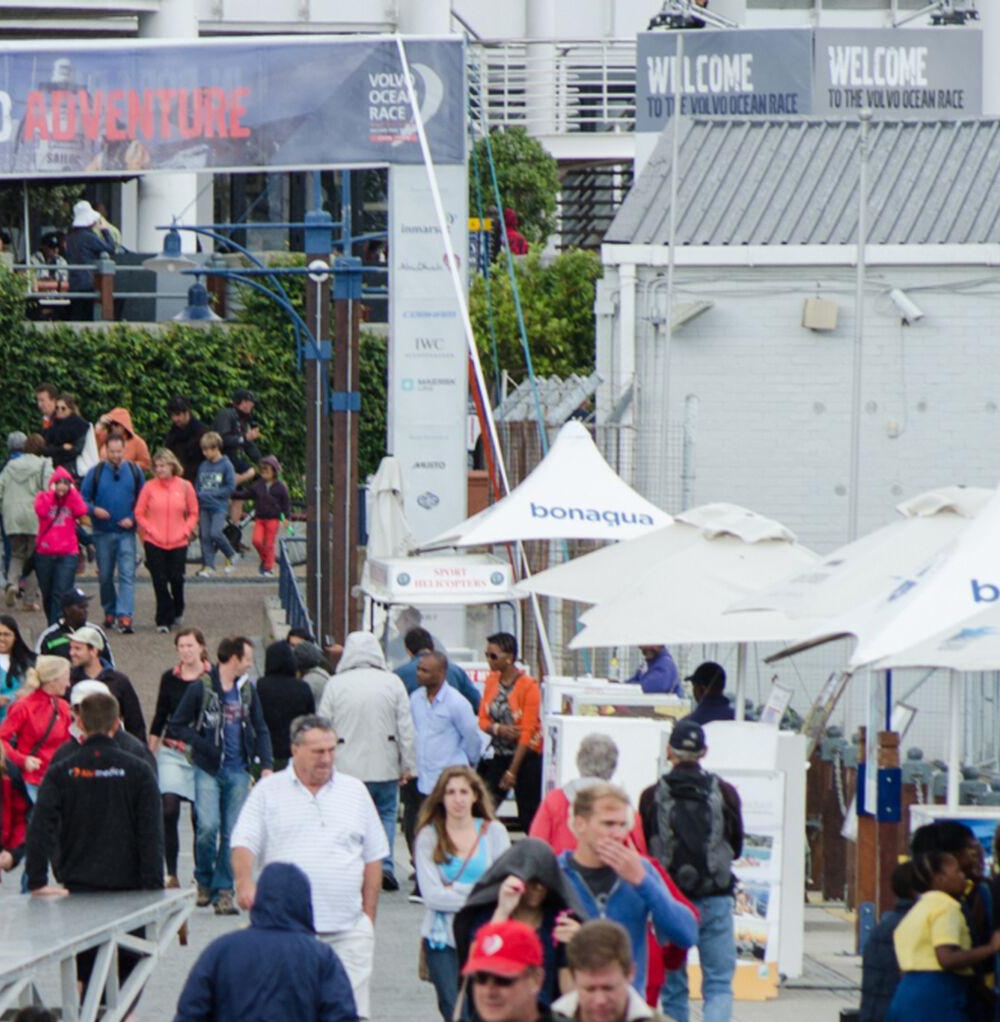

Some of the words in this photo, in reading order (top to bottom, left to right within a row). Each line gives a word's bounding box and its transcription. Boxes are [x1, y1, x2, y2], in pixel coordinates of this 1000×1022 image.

[646, 54, 754, 95] WELCOME
[828, 46, 928, 87] WELCOME
[369, 89, 418, 104] OCEA
[646, 96, 662, 118] TO
[690, 95, 727, 115] VOLVO
[730, 94, 767, 115] OCEAN
[769, 92, 798, 114] RACE
[828, 90, 842, 109] TO
[843, 89, 863, 109] THE
[866, 89, 900, 110] VOLVO
[902, 89, 936, 109] OCEAN
[938, 89, 964, 109] RACE
[24, 87, 252, 143] ADVENTURE
[369, 106, 406, 120] RACE
[400, 223, 451, 234] inmarst
[414, 337, 446, 351] IWC
[529, 502, 655, 527] bonaqua
[433, 567, 467, 577] SPORT
[413, 579, 488, 589] HELICOPTERS
